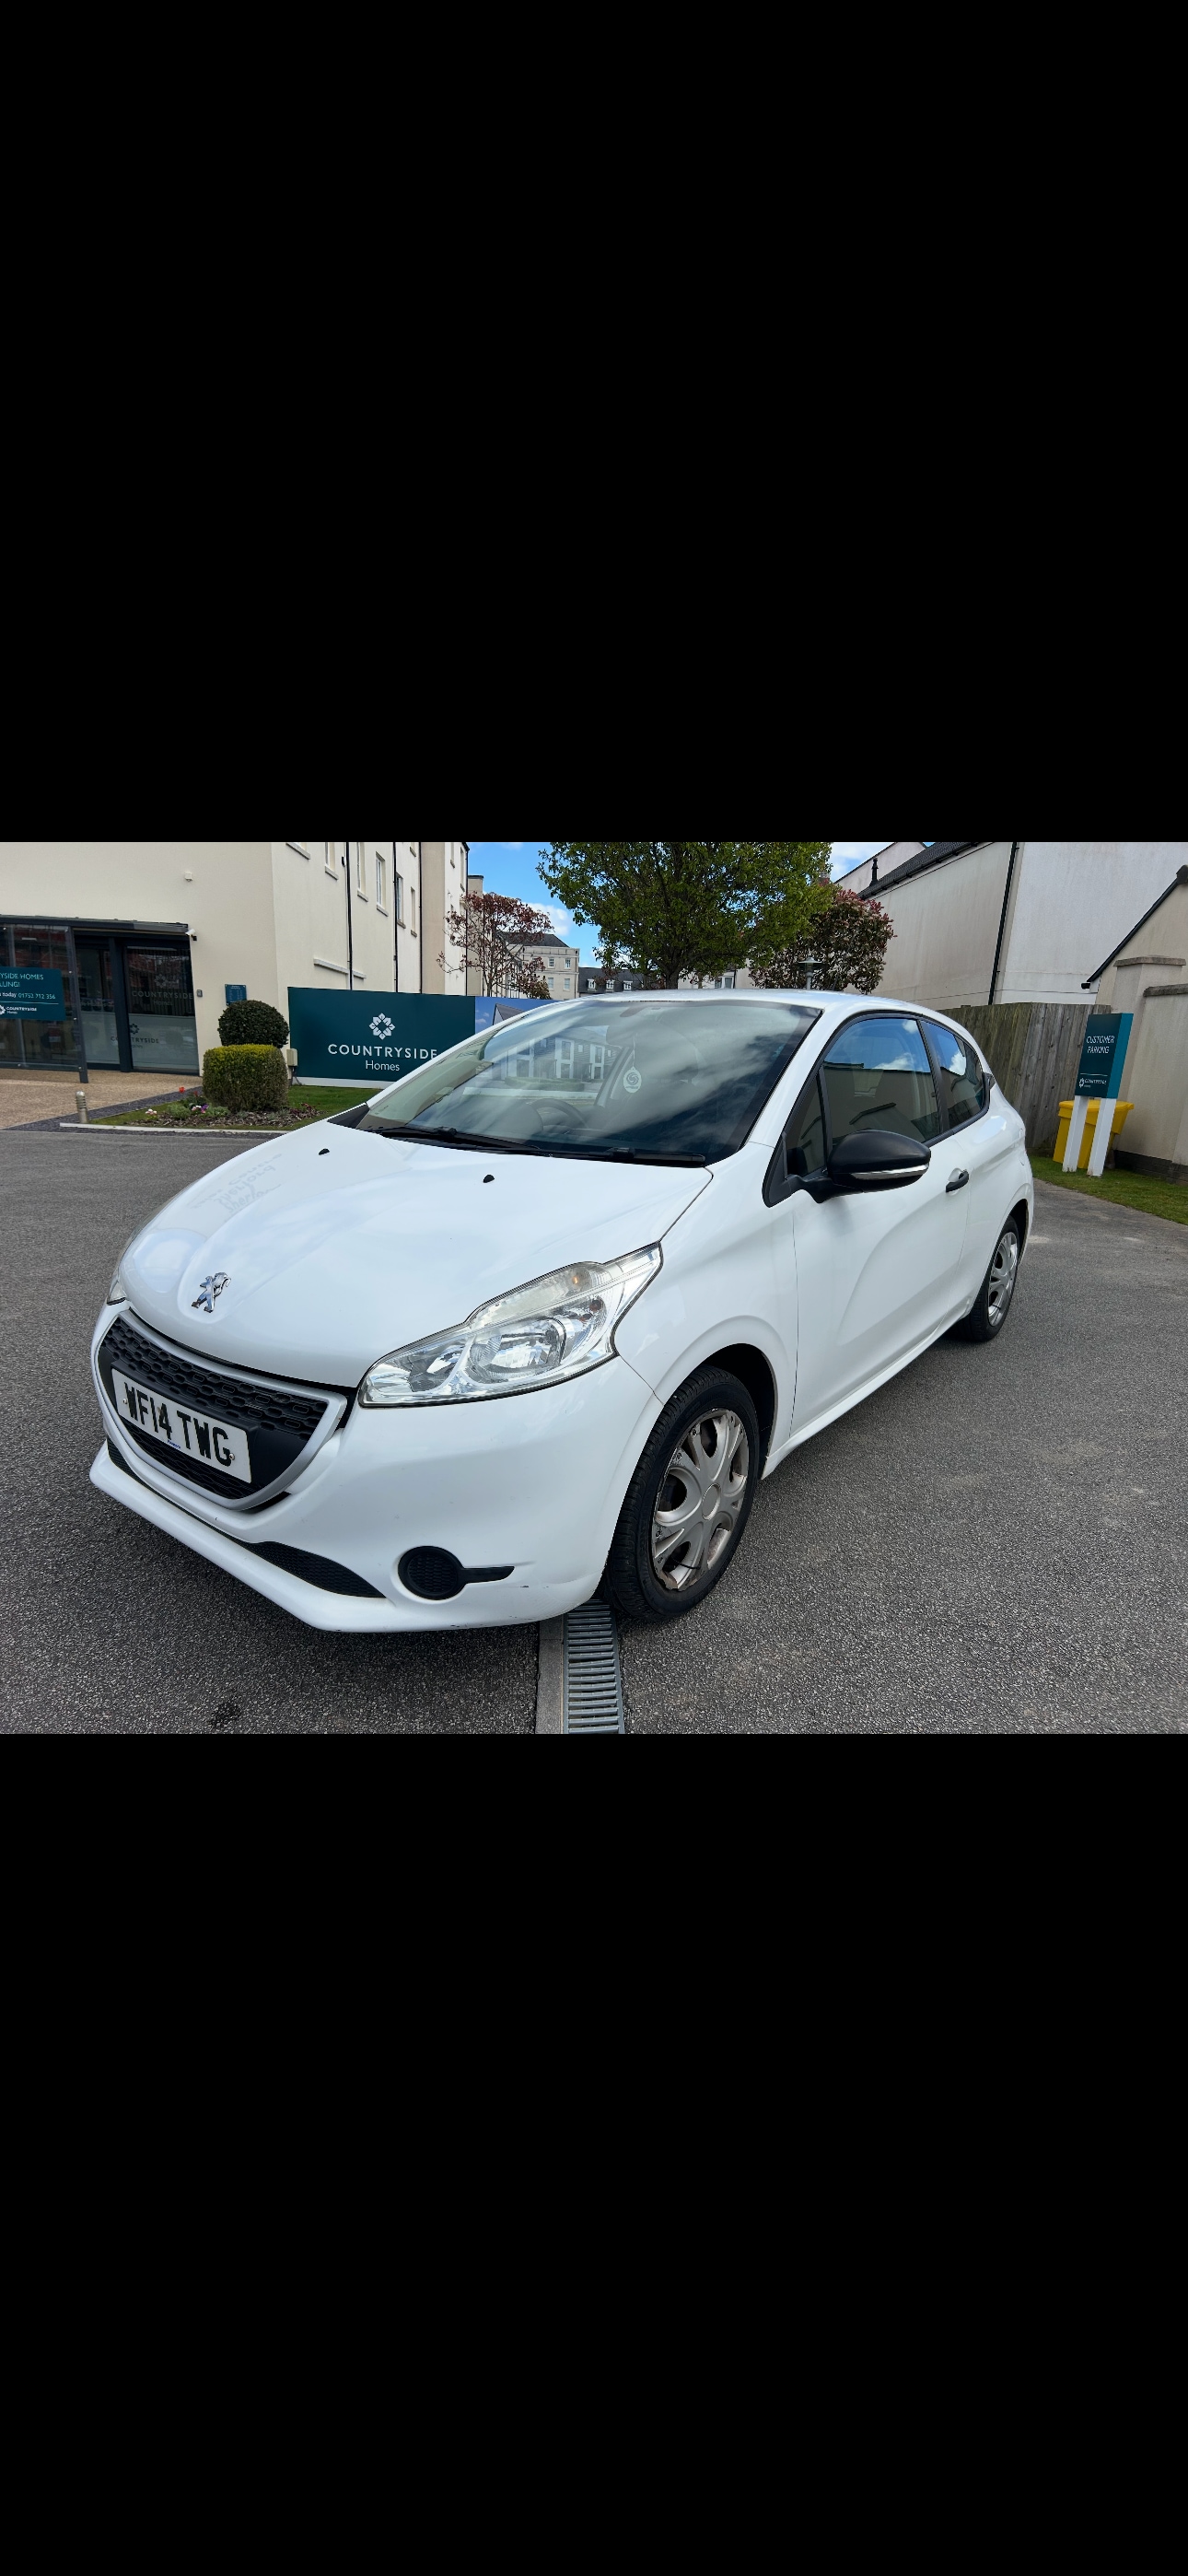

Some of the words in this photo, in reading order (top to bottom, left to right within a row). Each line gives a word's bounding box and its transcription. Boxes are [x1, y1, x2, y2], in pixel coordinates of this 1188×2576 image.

[132, 990, 193, 1000] COUNTRYSIDE
[111, 1036, 159, 1044] CTRYSIDE
[1086, 1035, 1115, 1044] CUSTOMER
[328, 1044, 437, 1060] COUNTRYSIDE
[1087, 1046, 1110, 1054] PARKING
[365, 1060, 401, 1071] Homes
[124, 1382, 173, 1440] WF14
[176, 1410, 232, 1467] TWG
